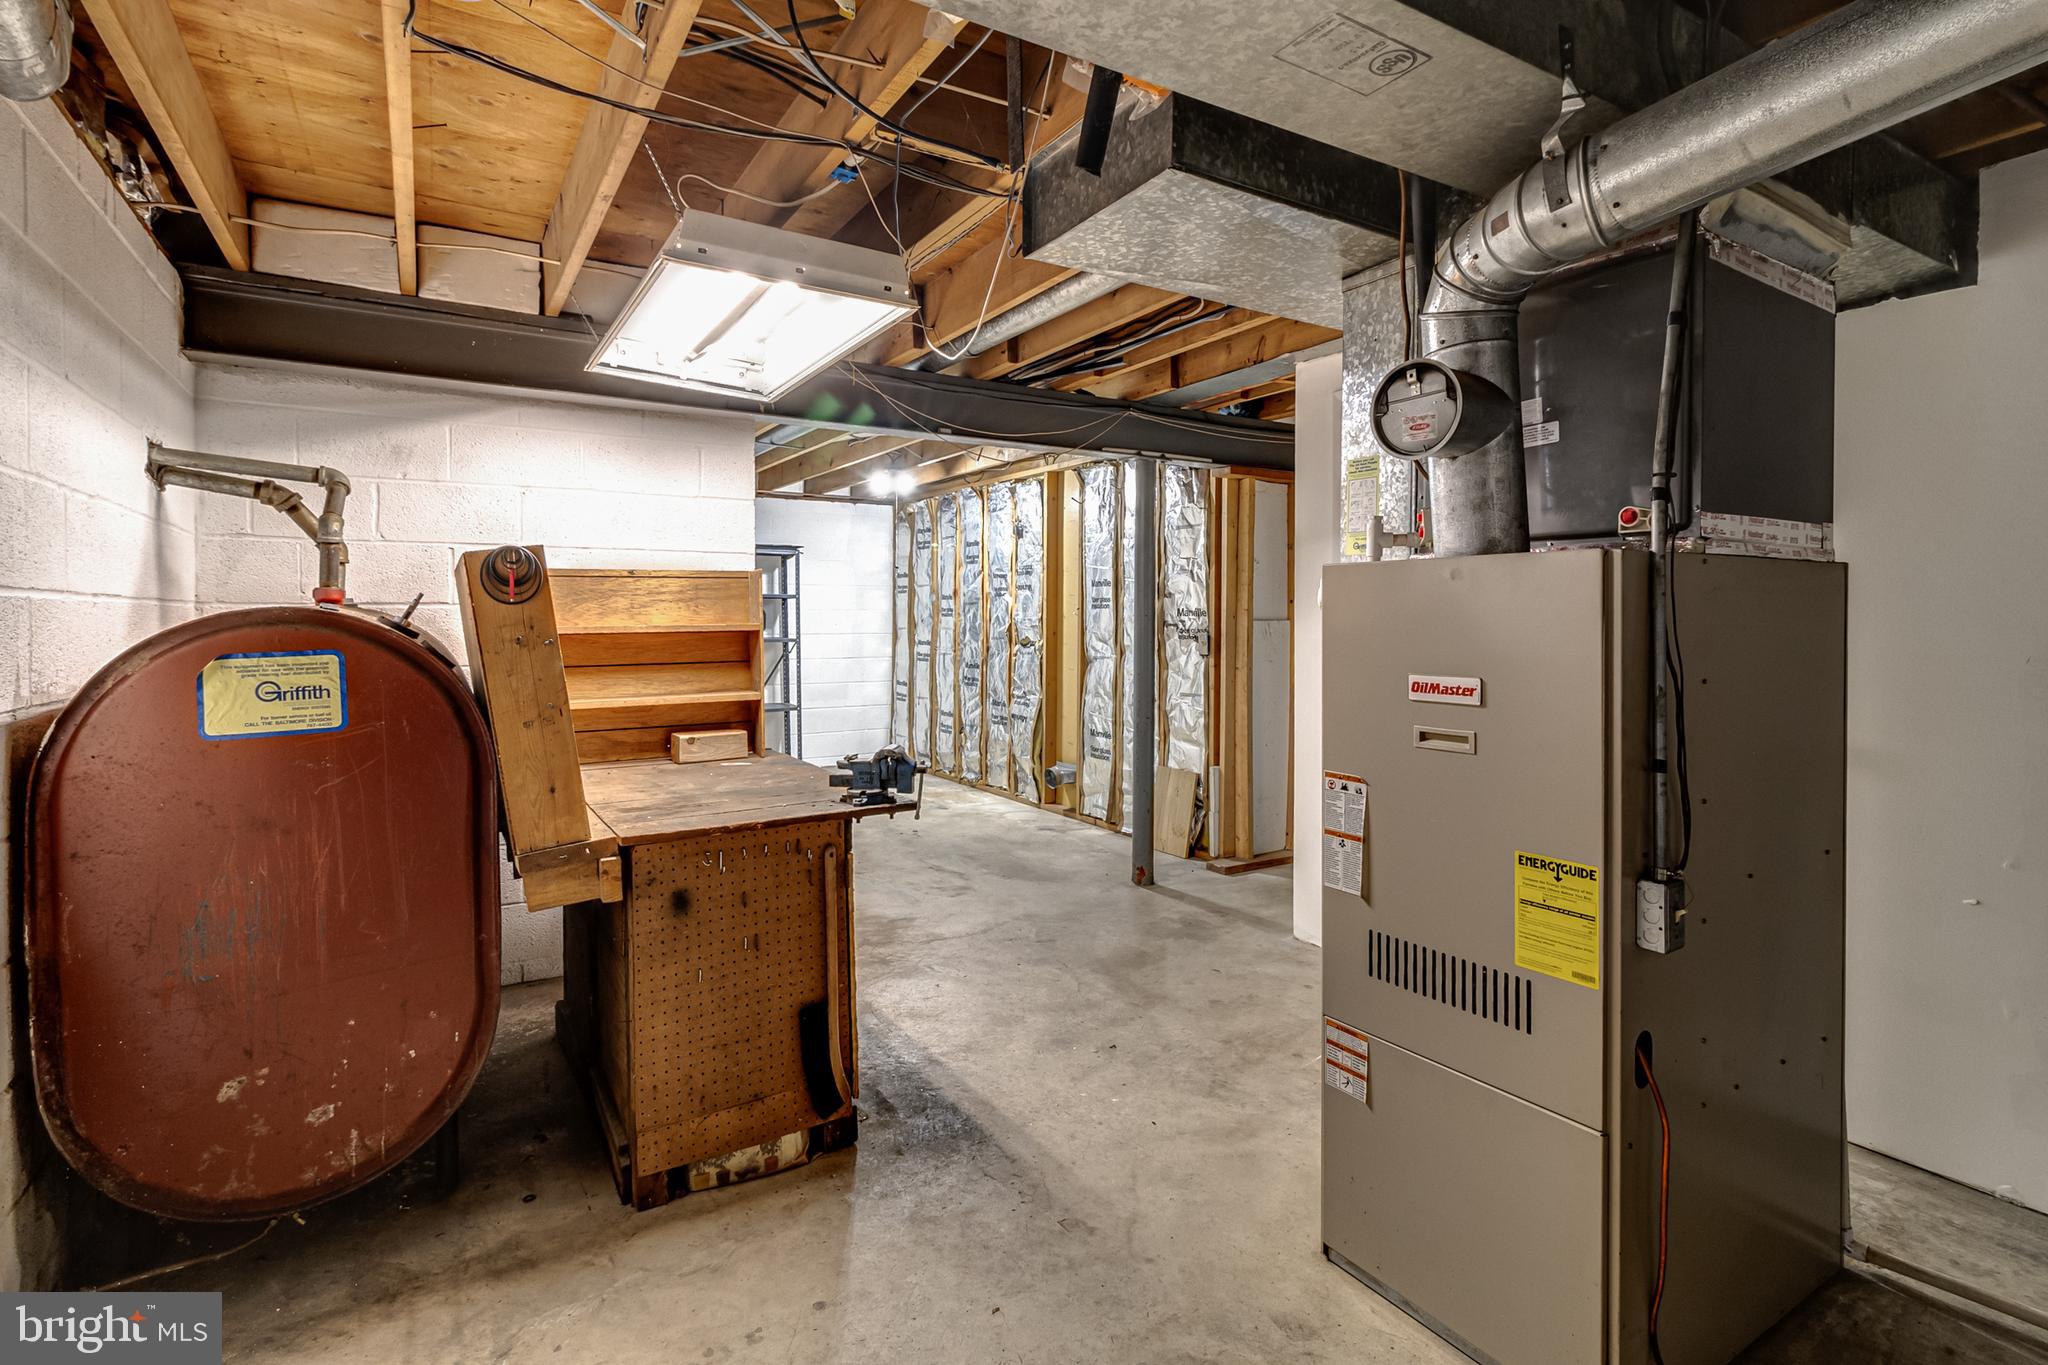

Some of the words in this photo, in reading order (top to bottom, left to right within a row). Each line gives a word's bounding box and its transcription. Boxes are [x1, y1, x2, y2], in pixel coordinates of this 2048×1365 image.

[256, 681, 330, 702] Griffith
[1411, 681, 1477, 697] OilMaster
[1518, 854, 1597, 881] ENERGYGUIDE
